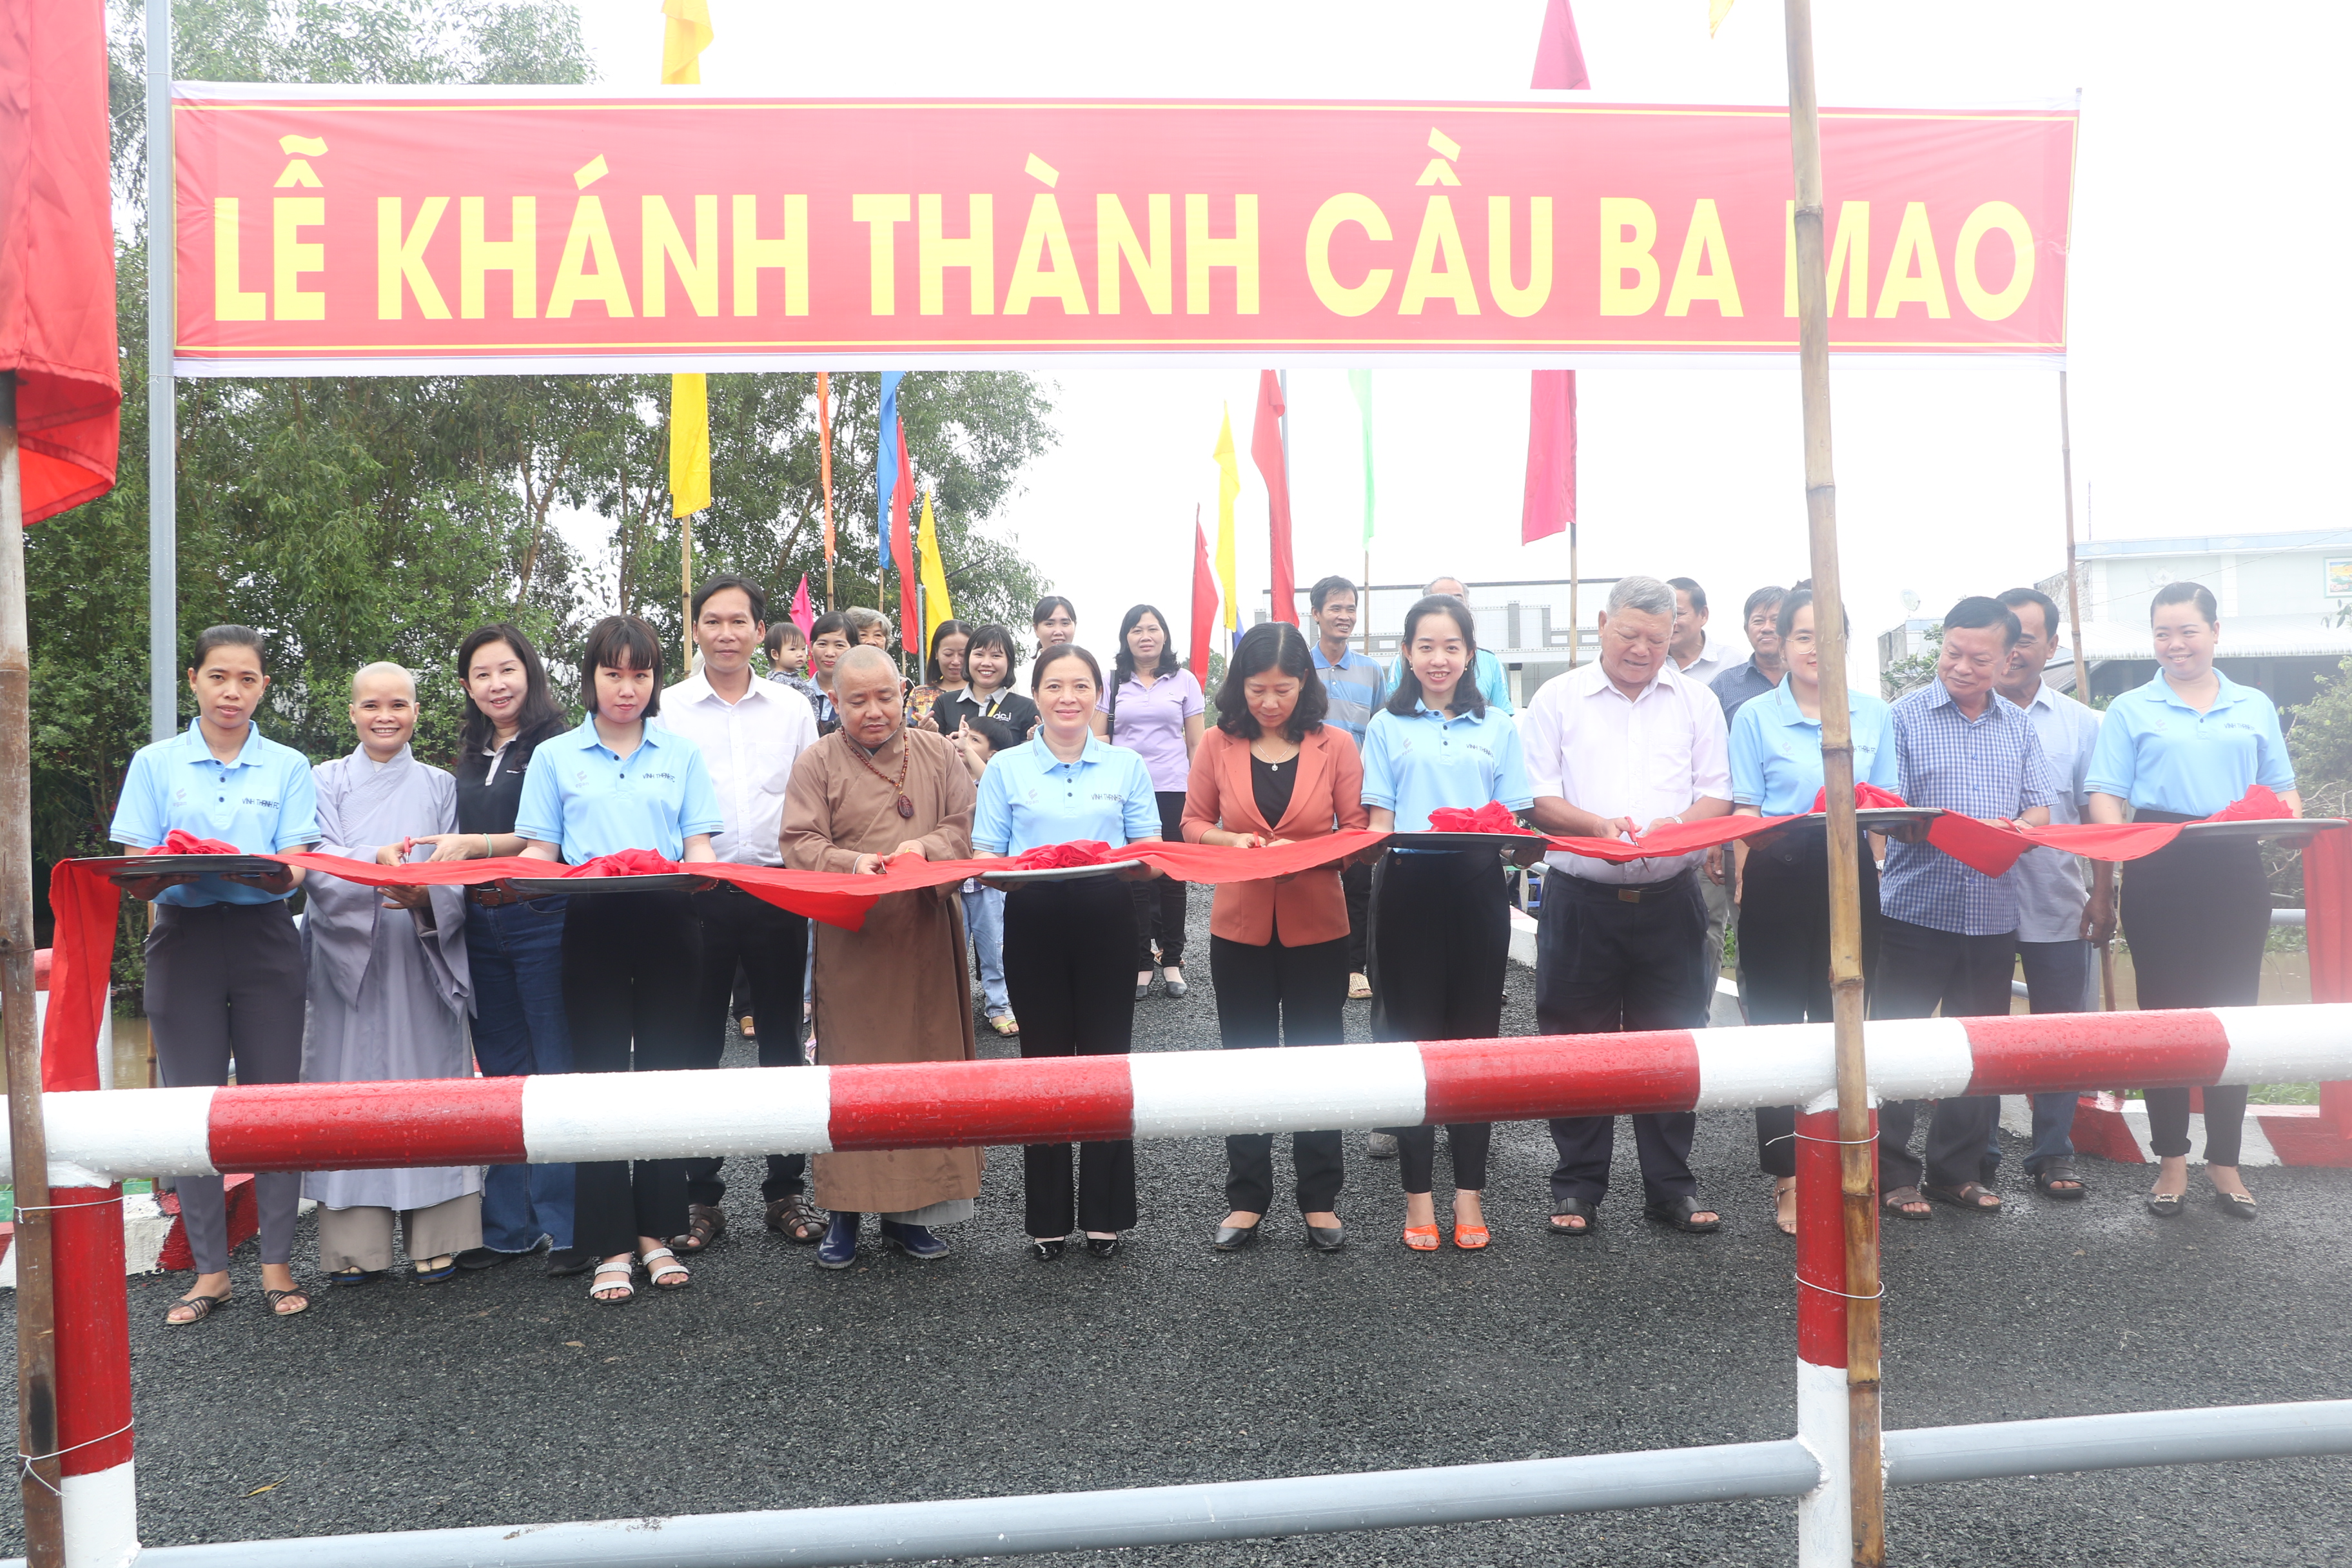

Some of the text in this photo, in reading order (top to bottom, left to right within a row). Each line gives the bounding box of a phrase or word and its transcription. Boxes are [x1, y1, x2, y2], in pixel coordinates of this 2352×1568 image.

[213, 126, 2035, 322] LỄ KHÁNH THÀNH CẦU BA MAO
